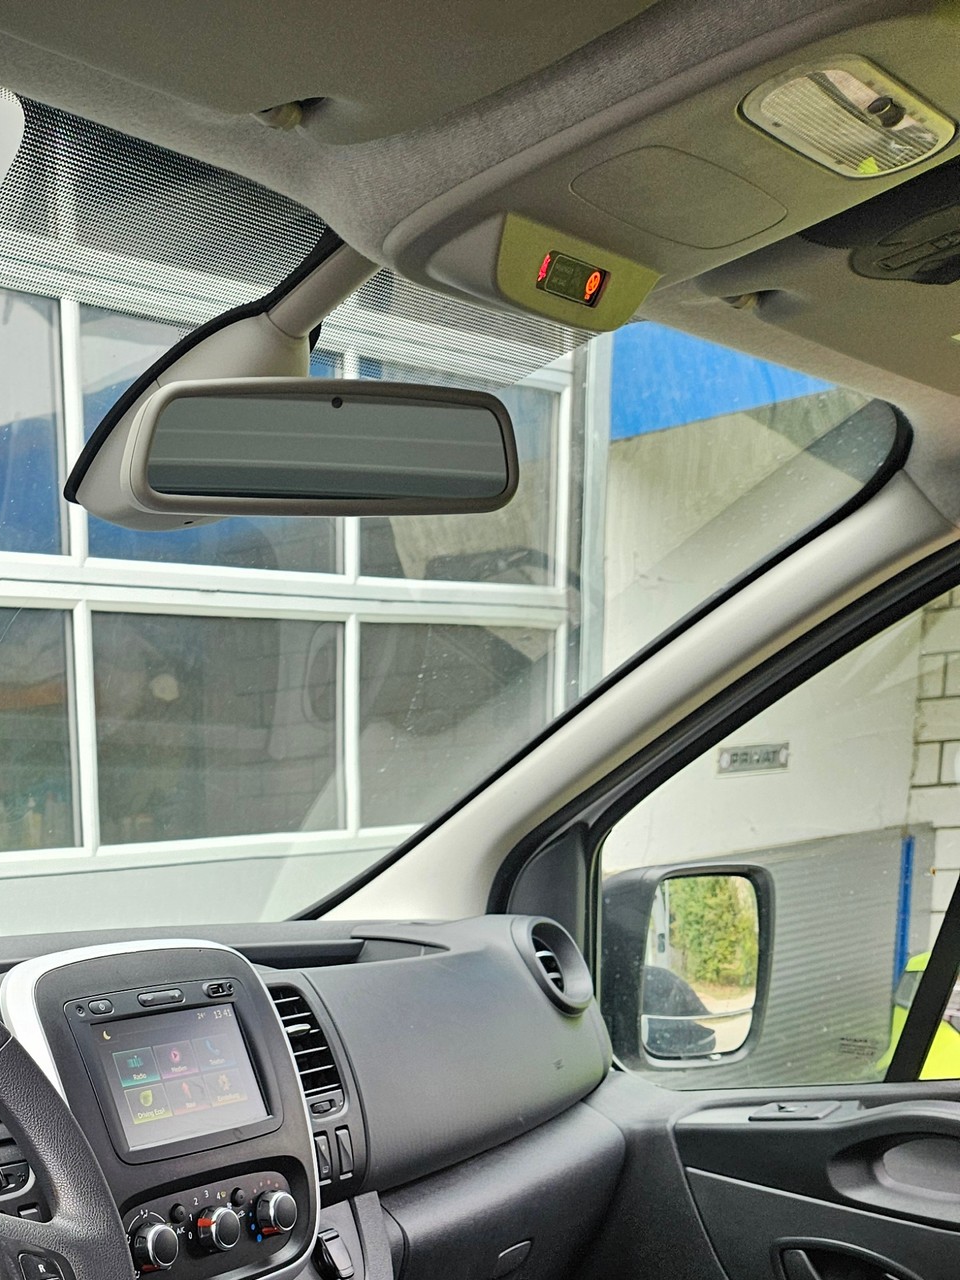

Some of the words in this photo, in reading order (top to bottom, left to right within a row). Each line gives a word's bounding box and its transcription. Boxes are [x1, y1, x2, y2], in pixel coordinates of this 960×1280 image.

[204, 1190, 209, 1198] 3
[216, 1192, 221, 1200] 4
[193, 1197, 199, 1206] 2
[38, 1264, 46, 1273] R
